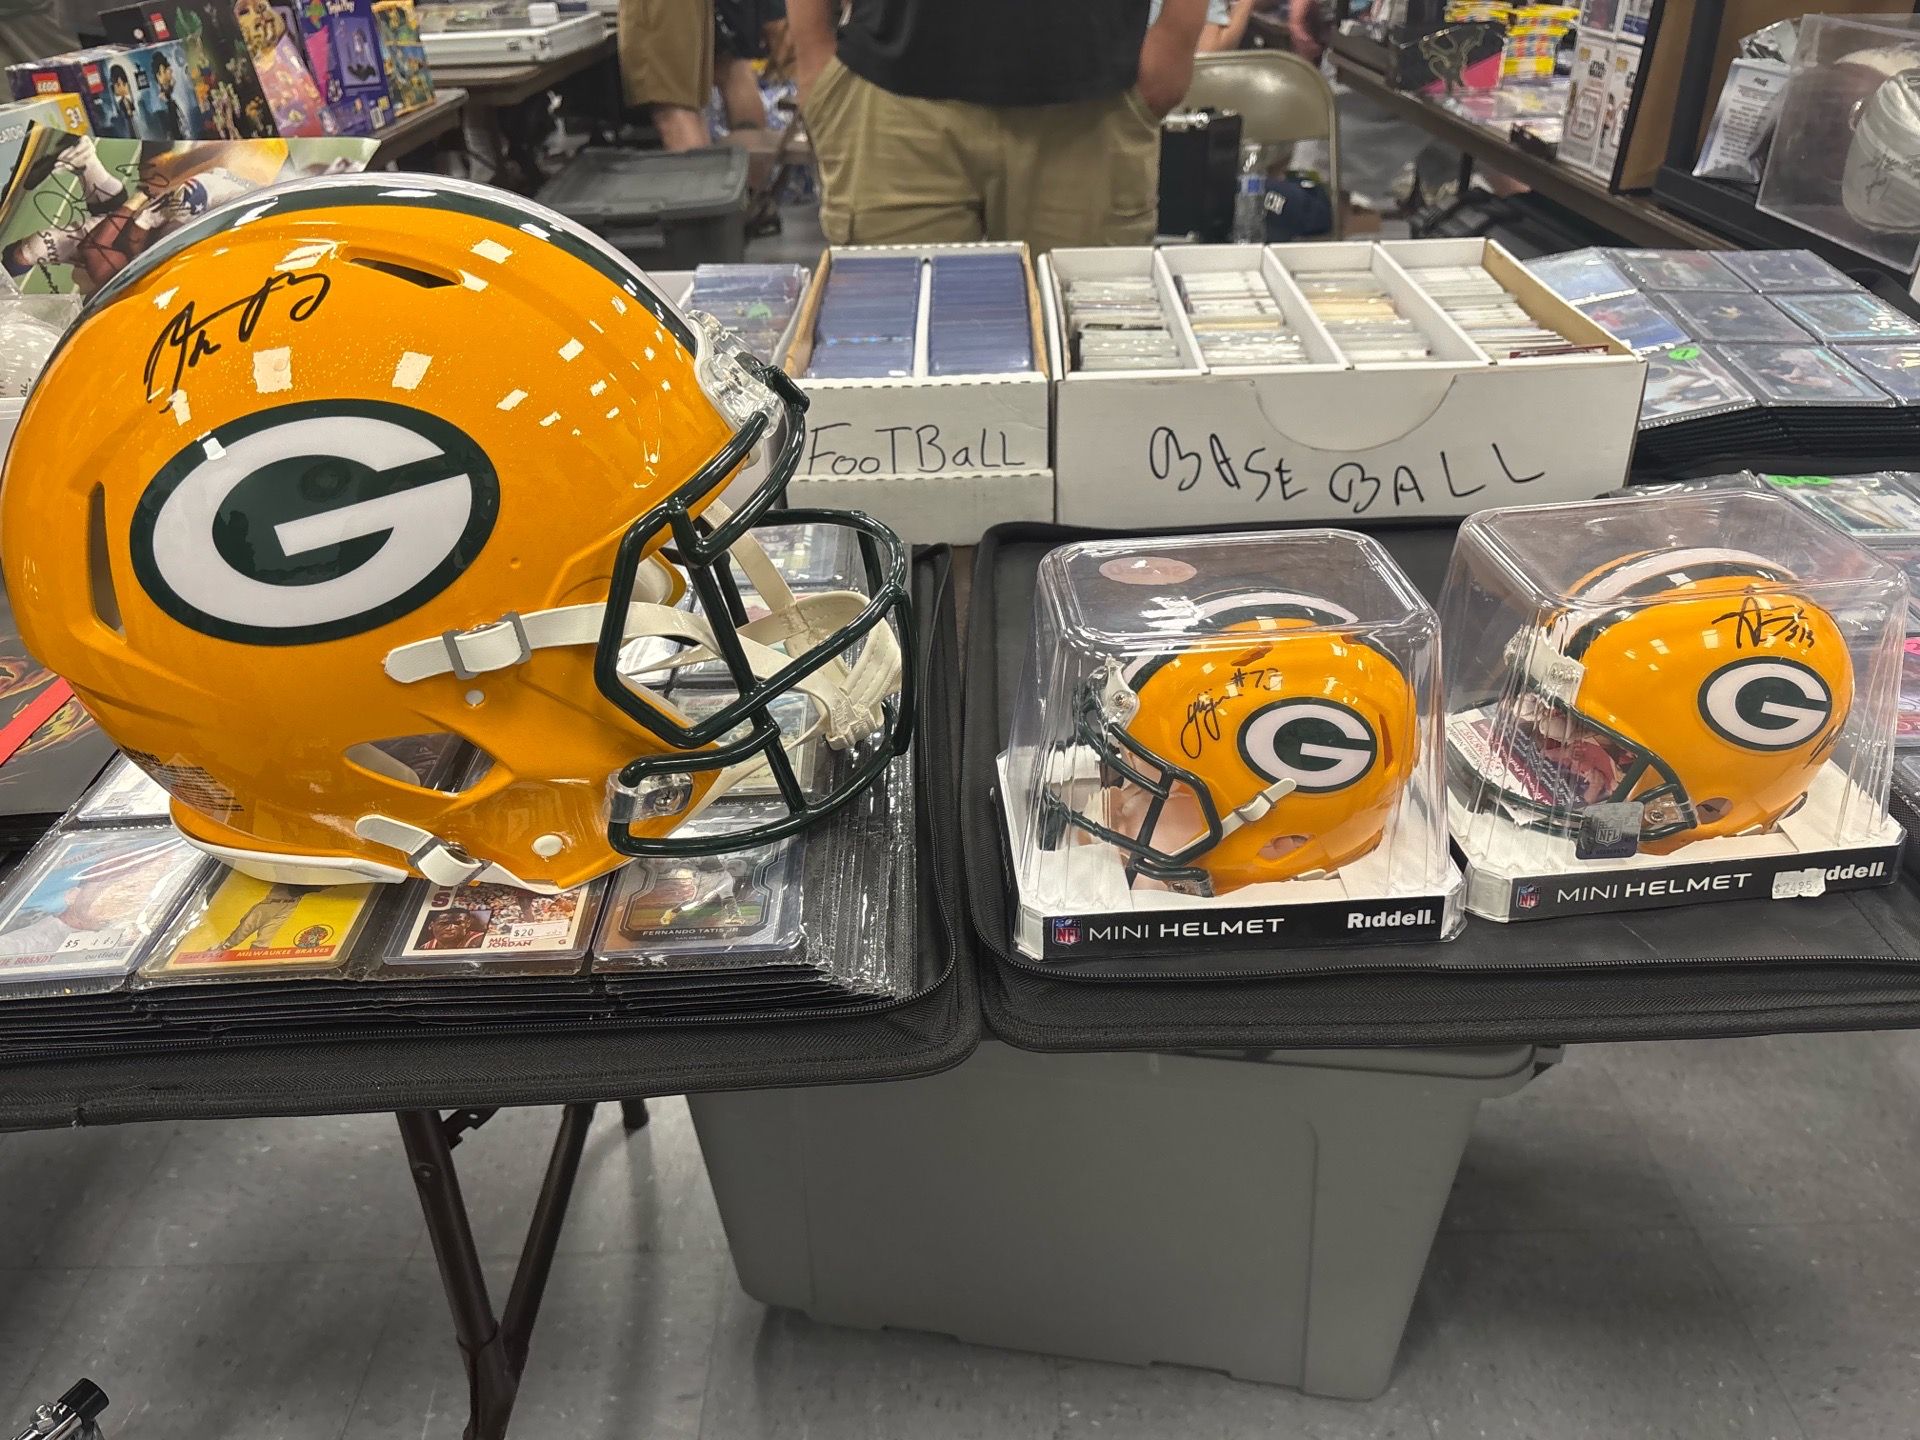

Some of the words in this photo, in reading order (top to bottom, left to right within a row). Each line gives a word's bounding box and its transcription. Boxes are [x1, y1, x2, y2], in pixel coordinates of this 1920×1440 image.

[37, 83, 59, 92] LEGO
[153, 416, 472, 627] G
[1707, 663, 1827, 745] G
[1245, 704, 1372, 788] G
[1599, 830, 1620, 842] NFL
[1557, 885, 1618, 903] MINI
[1625, 872, 1753, 898] HELMET
[1826, 862, 1885, 881] ddell
[1519, 893, 1539, 907] NFL
[1089, 924, 1149, 942] MINI
[1159, 918, 1285, 938] HELMET
[1347, 909, 1432, 929] Riddell
[513, 928, 534, 937] $20
[642, 929, 696, 937] FERNANDO
[1056, 926, 1081, 945] NFL
[66, 938, 80, 949] $5
[487, 940, 533, 949] JORDAN
[84, 951, 123, 962] outfield
[236, 949, 292, 958] MILWAUKEE
[295, 947, 329, 955] BRAVES
[14, 954, 56, 966] BRANDT
